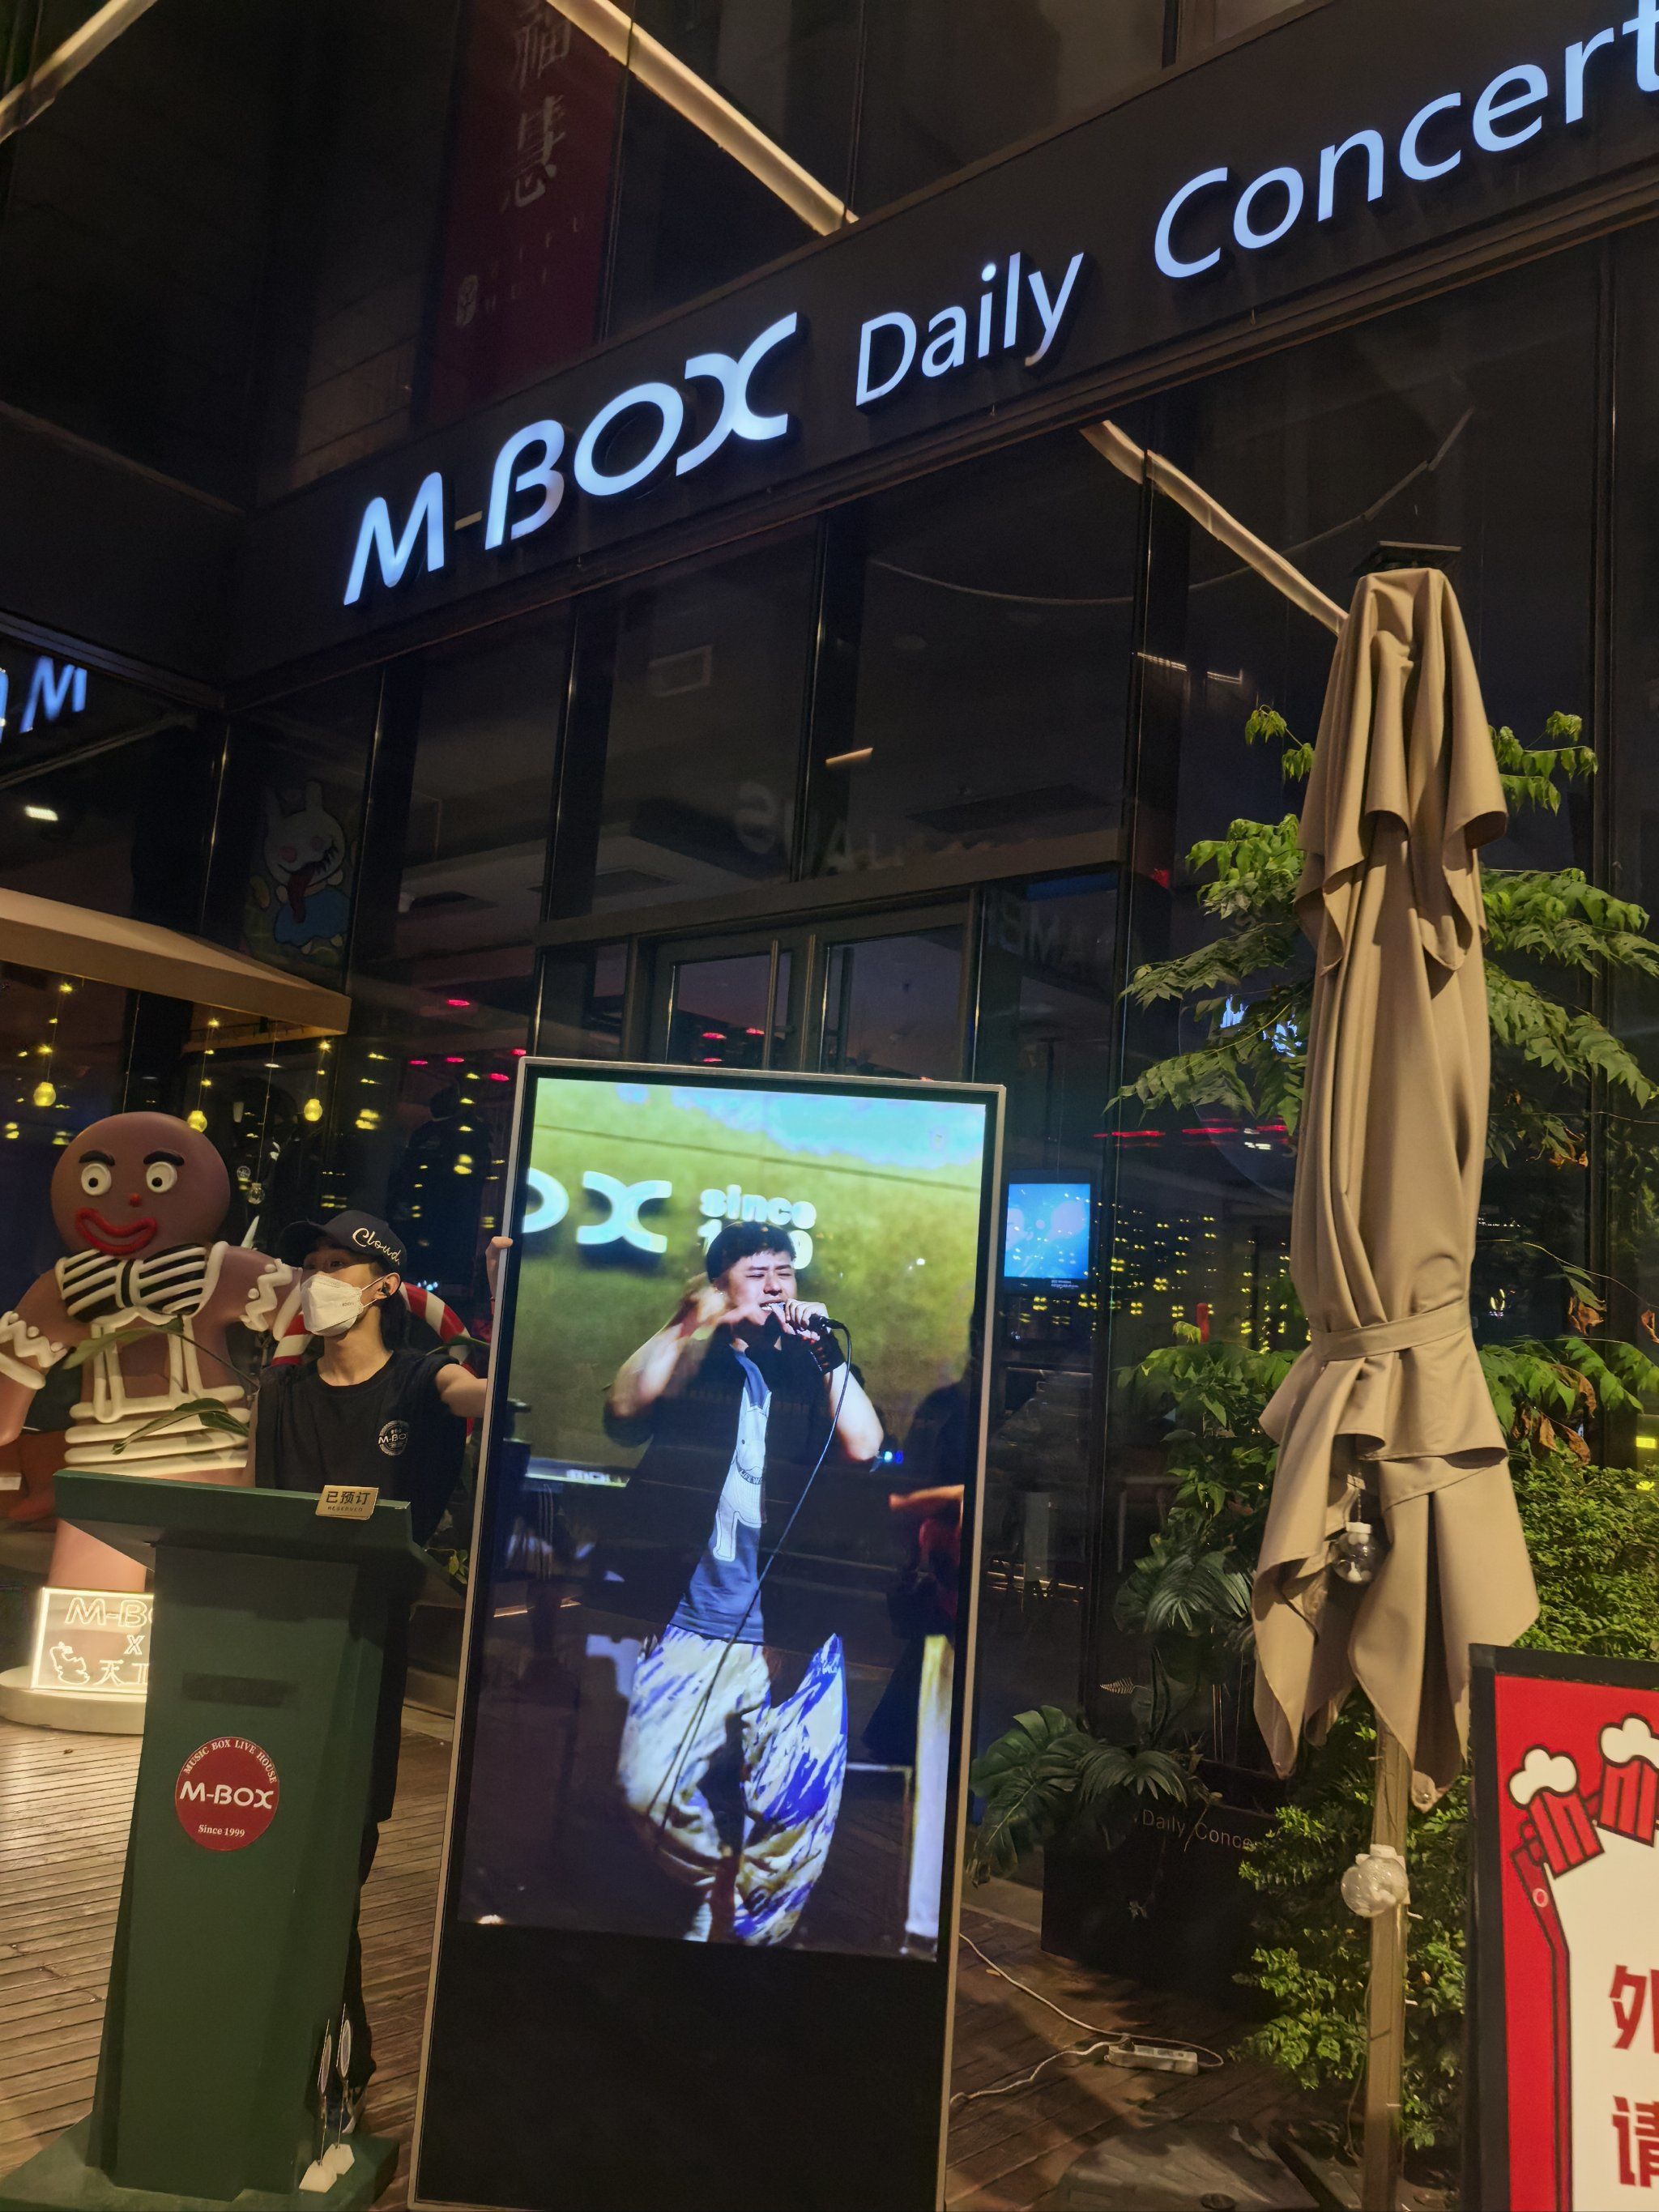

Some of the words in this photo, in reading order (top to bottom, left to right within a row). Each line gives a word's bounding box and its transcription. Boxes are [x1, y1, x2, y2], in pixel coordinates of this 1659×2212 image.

[343, 312, 797, 606] M-BOX
[856, 252, 1084, 406] Daily
[1154, 0, 1659, 278] Concert
[326, 1490, 371, 1505] 已预订
[65, 1597, 153, 1627] M-B
[183, 1746, 210, 1775] MUSIC
[211, 1739, 232, 1751] BOX
[234, 1740, 257, 1754] LIVE
[256, 1752, 277, 1784] HOUSE
[179, 1780, 275, 1809] M-BOX
[198, 1824, 223, 1836] Since
[224, 1827, 245, 1838] 1999
[1143, 1809, 1186, 1838] Daily
[1195, 1822, 1254, 1850] Conce
